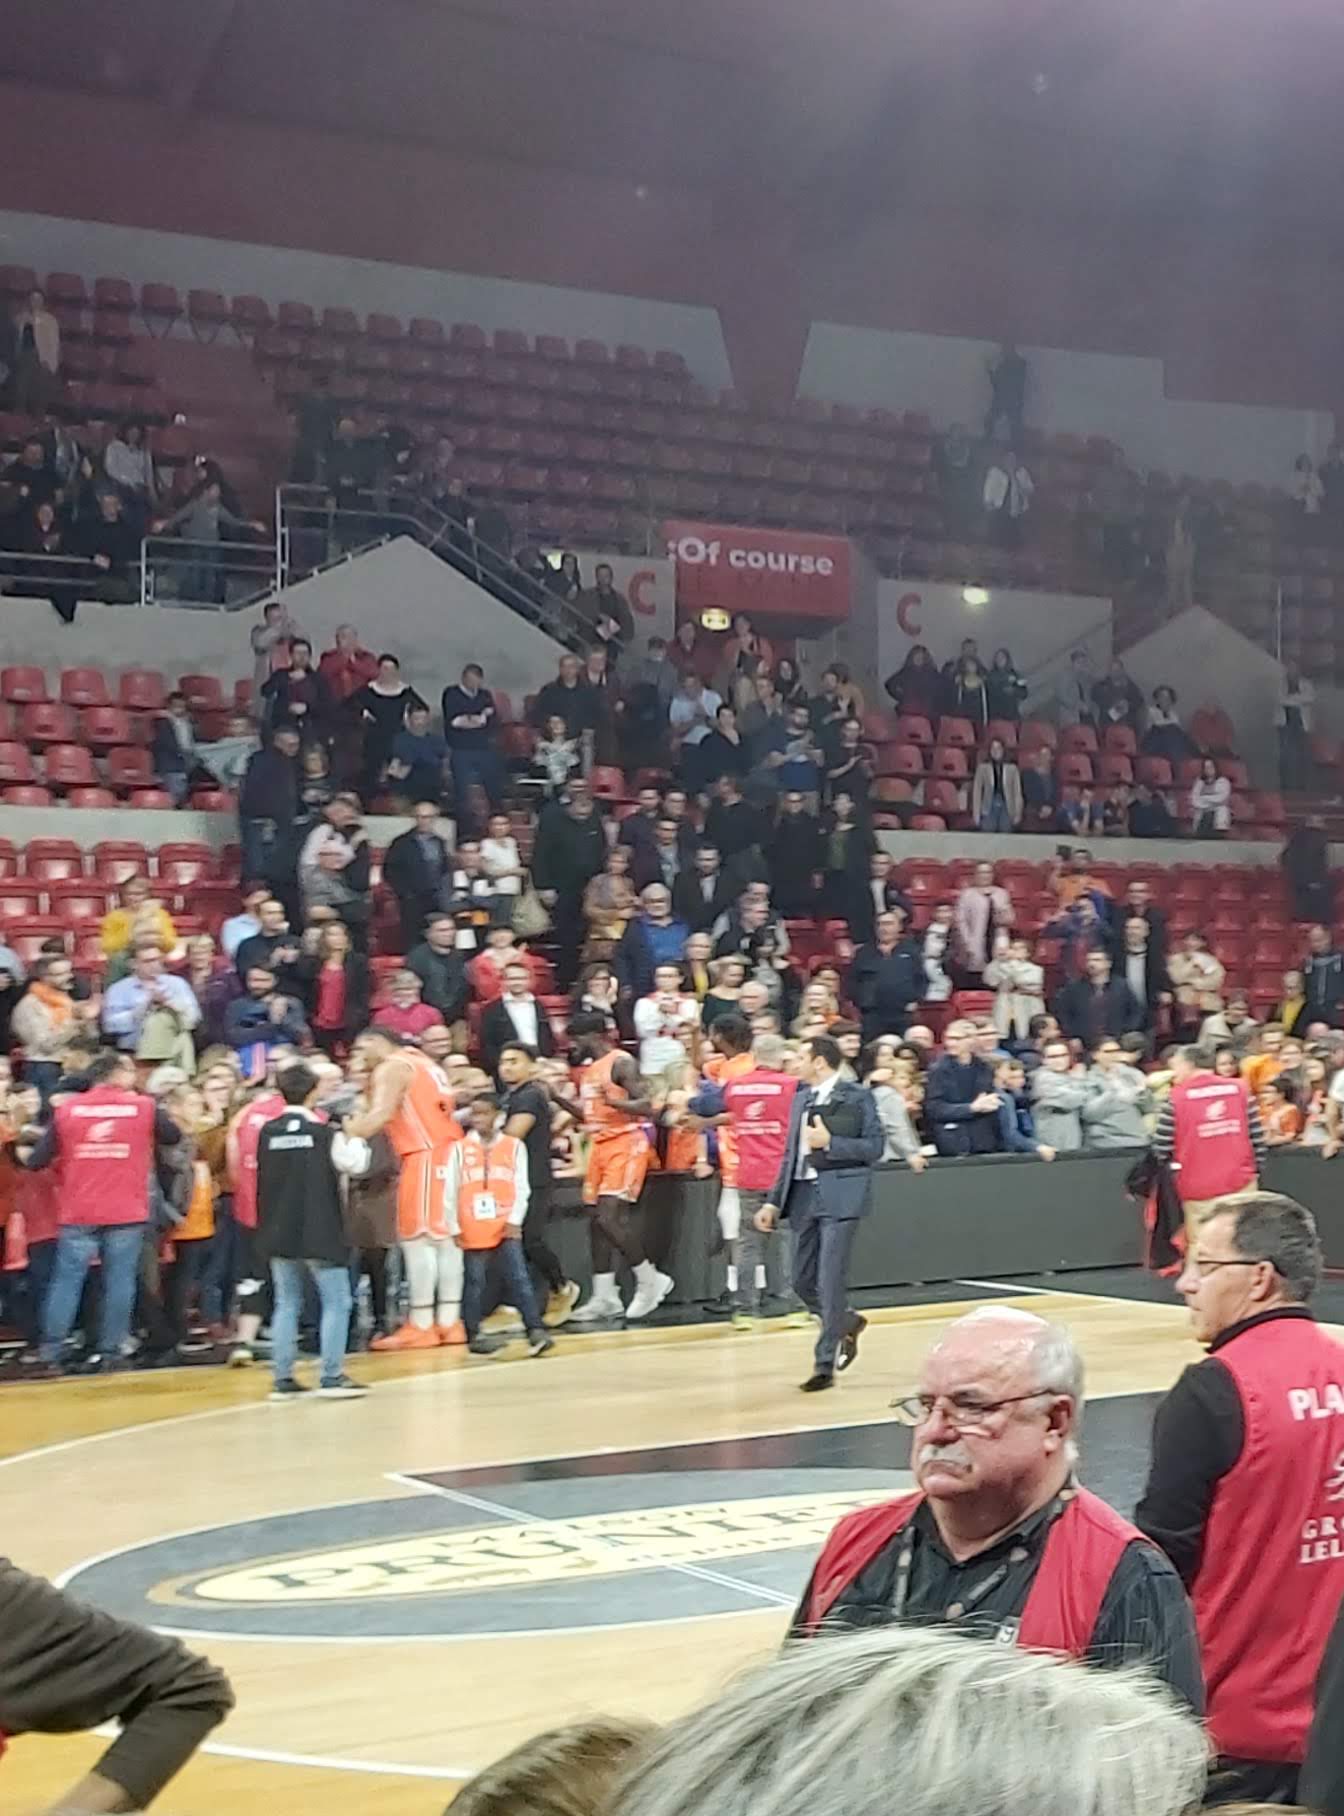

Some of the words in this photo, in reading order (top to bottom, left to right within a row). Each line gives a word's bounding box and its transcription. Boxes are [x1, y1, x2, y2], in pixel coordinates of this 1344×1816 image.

[729, 549, 834, 577] course
[628, 570, 657, 615] C
[896, 592, 922, 636] C
